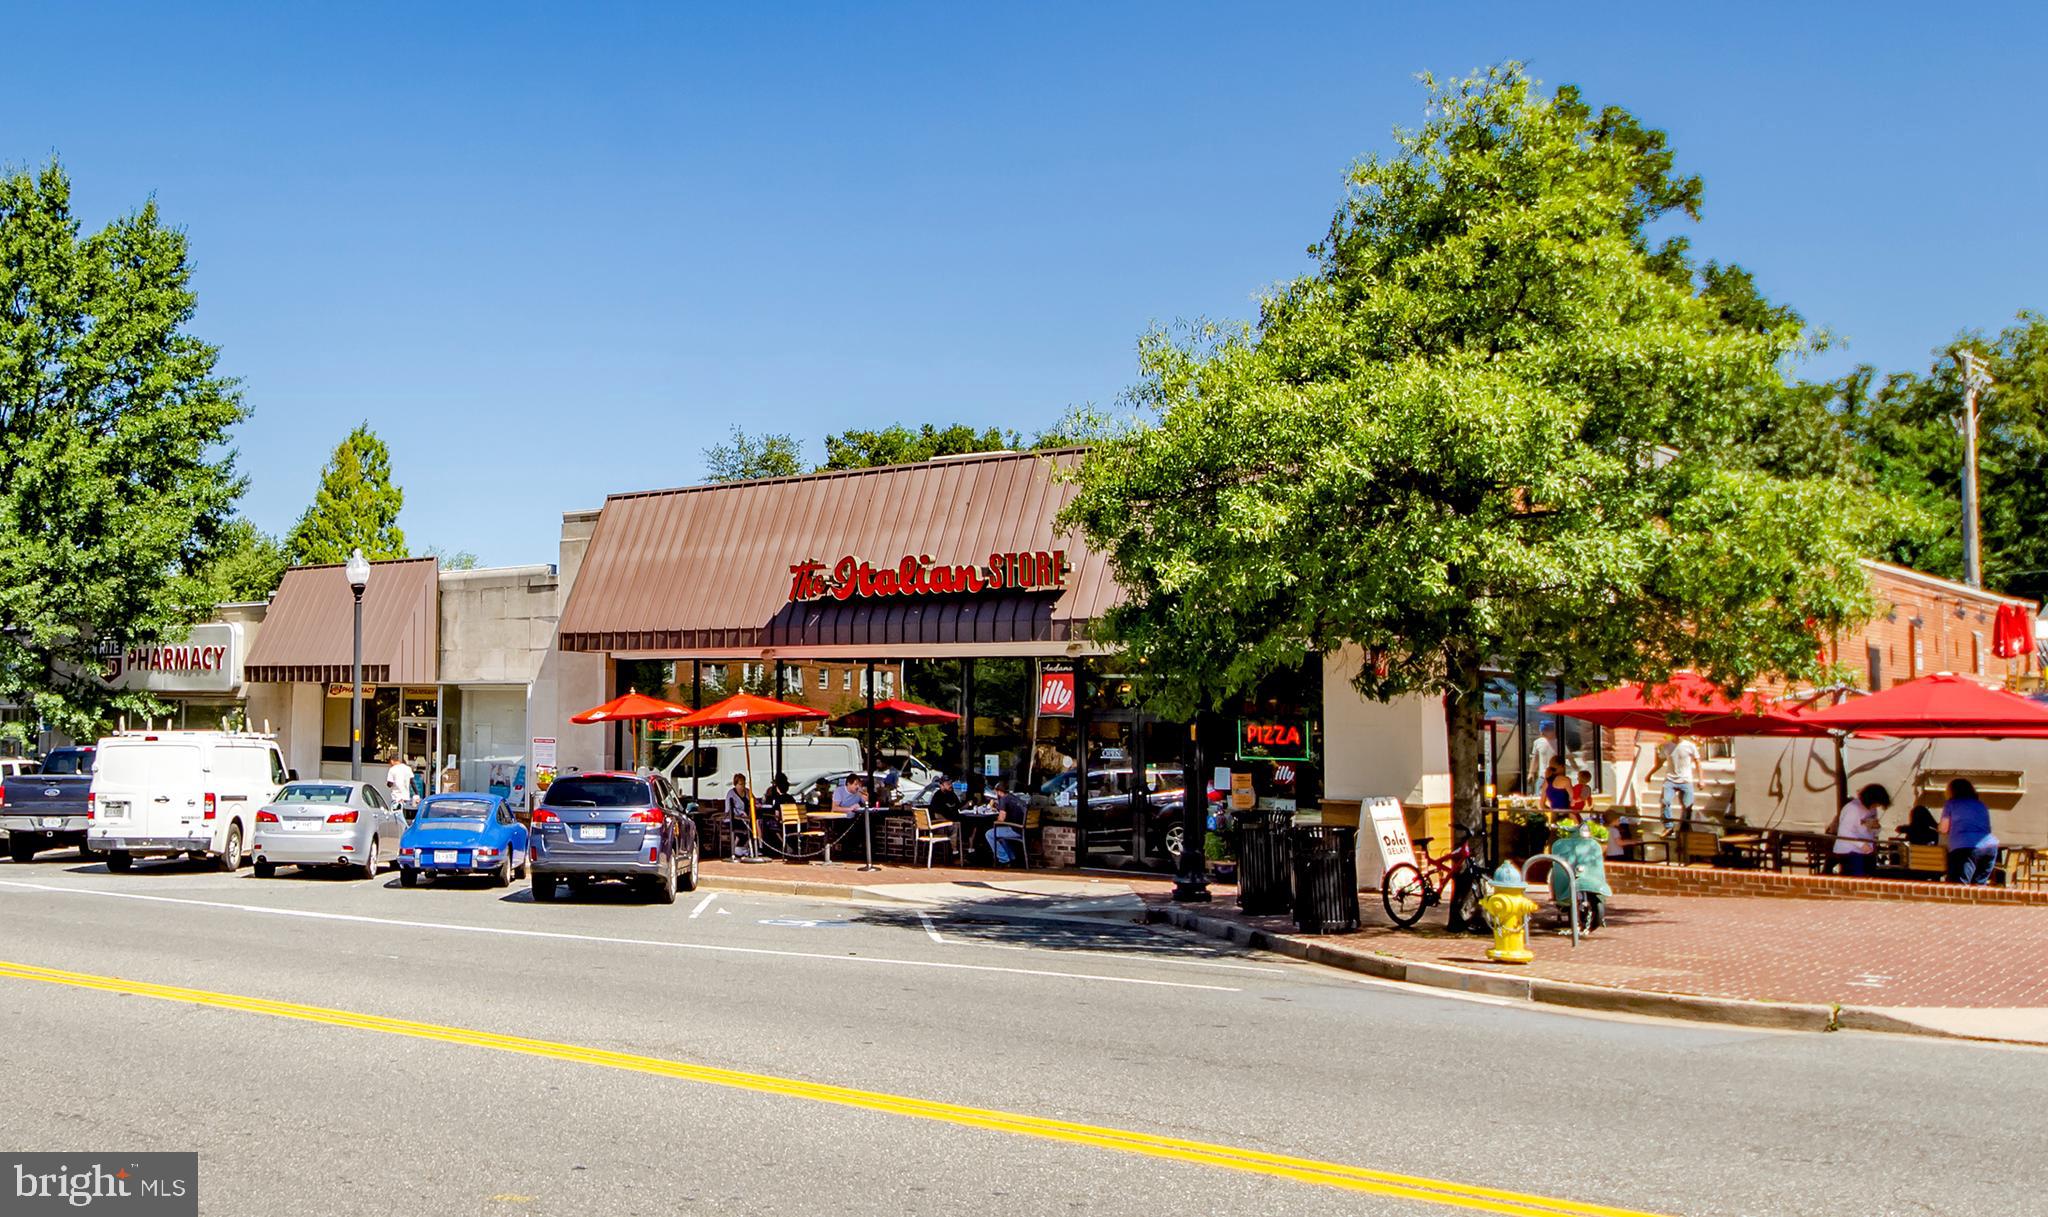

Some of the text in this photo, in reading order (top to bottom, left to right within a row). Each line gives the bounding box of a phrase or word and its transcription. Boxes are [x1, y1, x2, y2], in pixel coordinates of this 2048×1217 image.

[789, 550, 1066, 601] The Italian STORE
[127, 646, 227, 671] PHARMACY
[1042, 680, 1072, 710] illy
[1247, 724, 1300, 745] PIZZA
[1275, 765, 1295, 784] illy
[1383, 830, 1406, 846] Dolci
